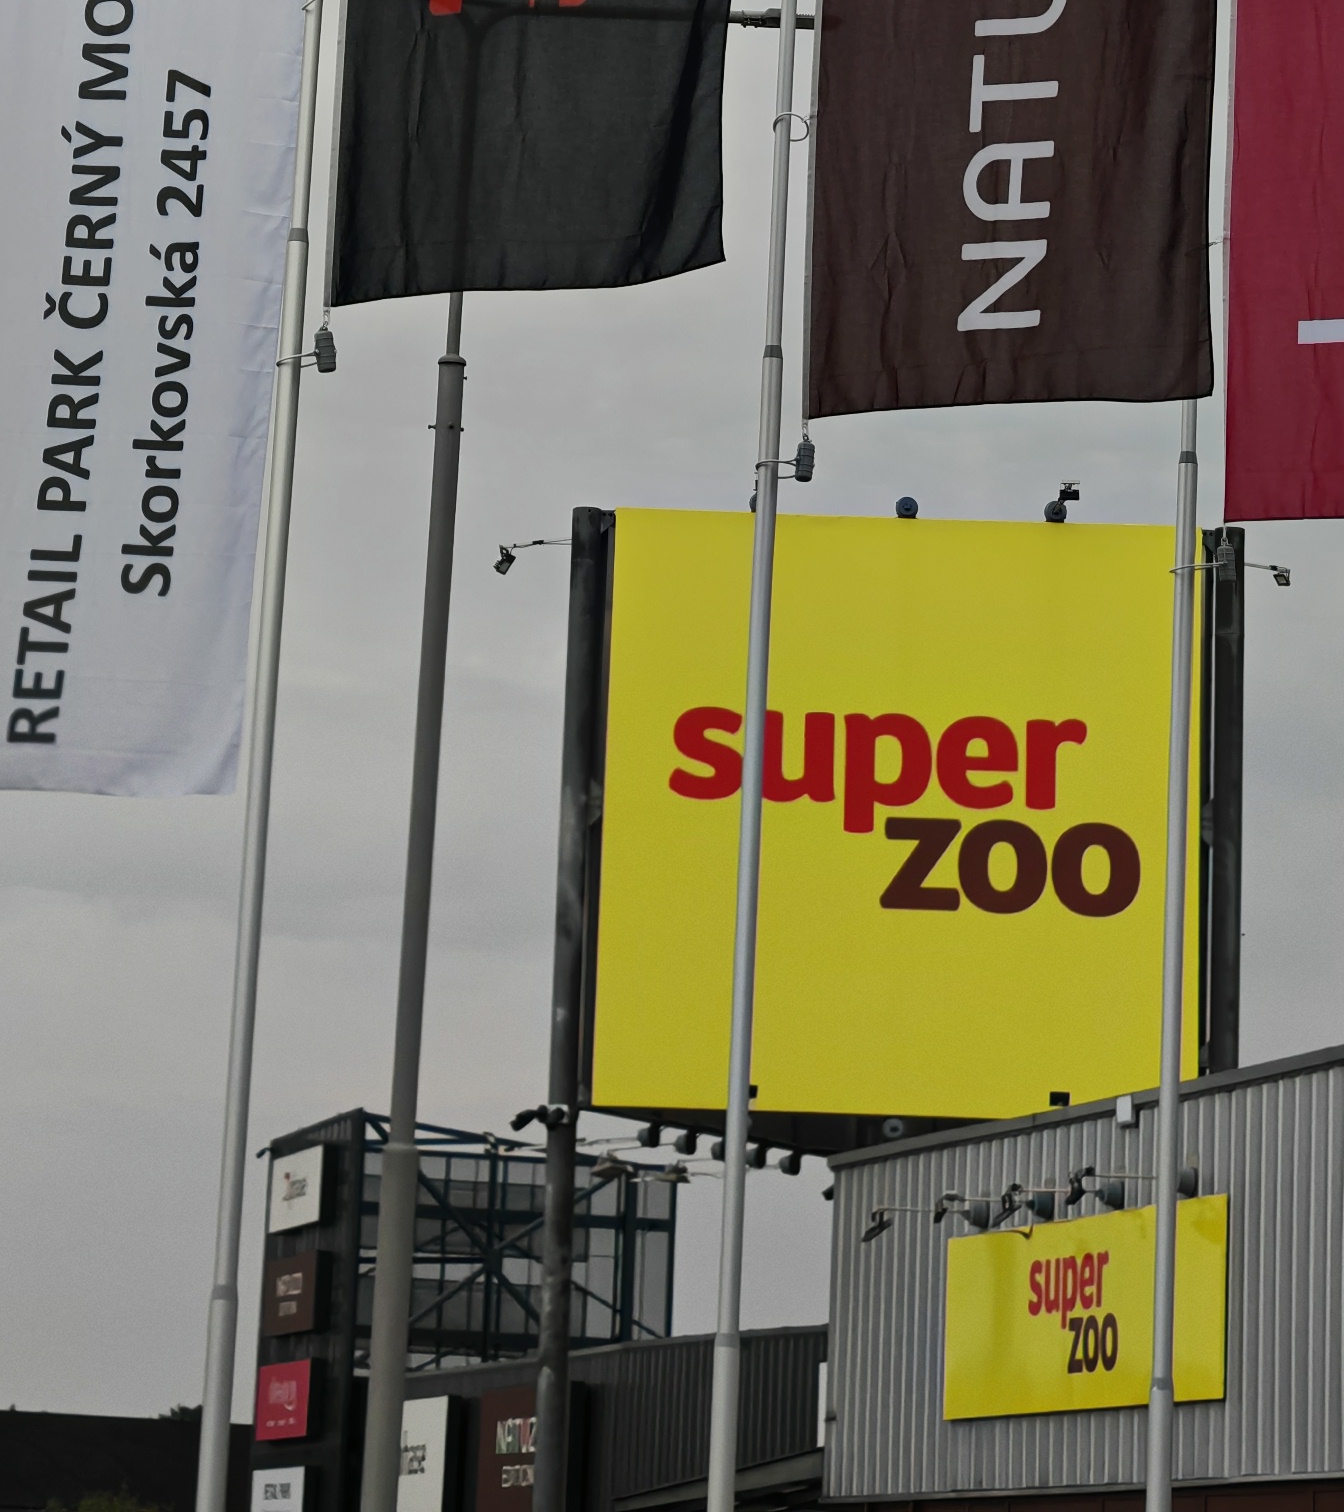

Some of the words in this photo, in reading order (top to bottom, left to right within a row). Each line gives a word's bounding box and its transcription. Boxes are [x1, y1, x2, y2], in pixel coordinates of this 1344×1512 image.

[156, 69, 212, 218] 2457
[43, 120, 124, 330] ČERNÝ
[36, 348, 104, 512] PARK
[120, 241, 200, 597] Skorkovská
[6, 534, 83, 745] RETAIL
[668, 706, 1088, 834] super
[879, 817, 1141, 918] zoo
[1028, 1250, 1109, 1330] super
[1067, 1312, 1119, 1375] zoo
